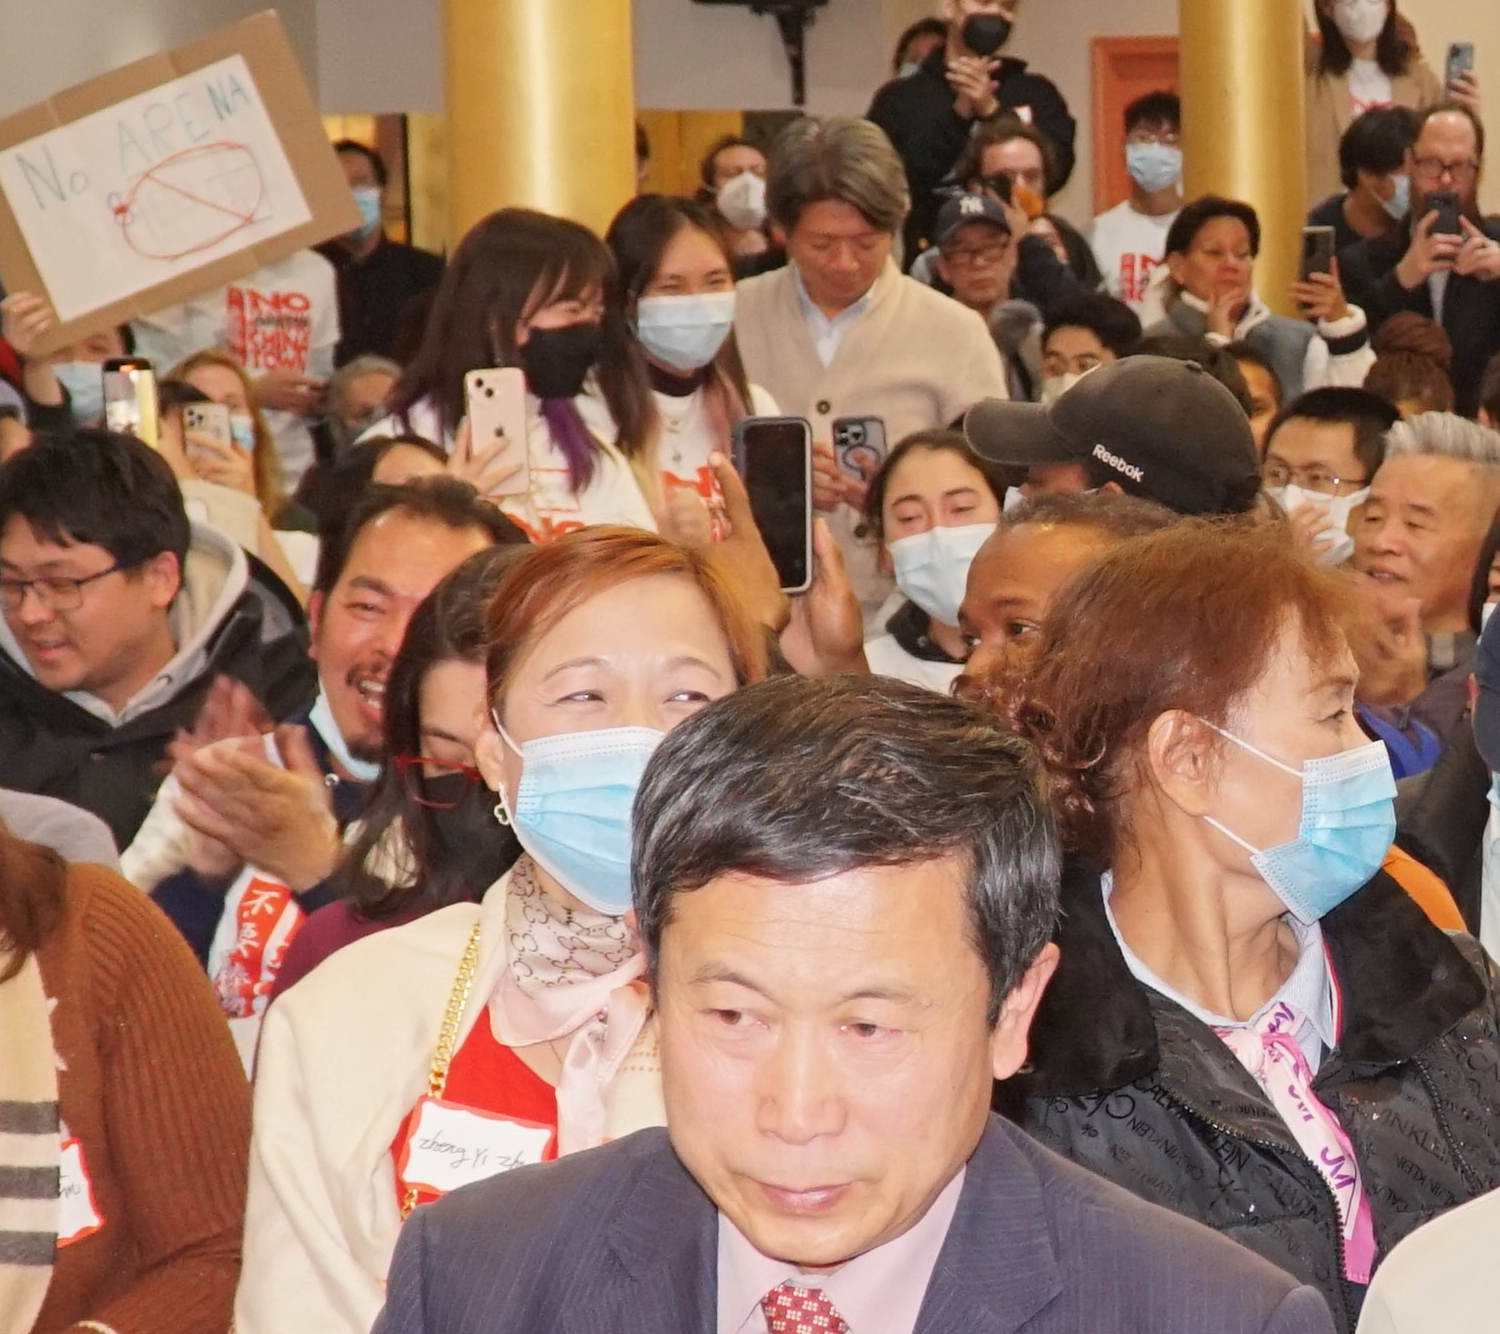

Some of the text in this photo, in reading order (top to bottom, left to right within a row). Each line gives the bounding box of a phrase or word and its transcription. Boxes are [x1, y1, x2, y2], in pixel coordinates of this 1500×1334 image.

[15, 74, 250, 210] No ARENA
[249, 289, 310, 311] NO
[1091, 442, 1146, 484] Reebok
